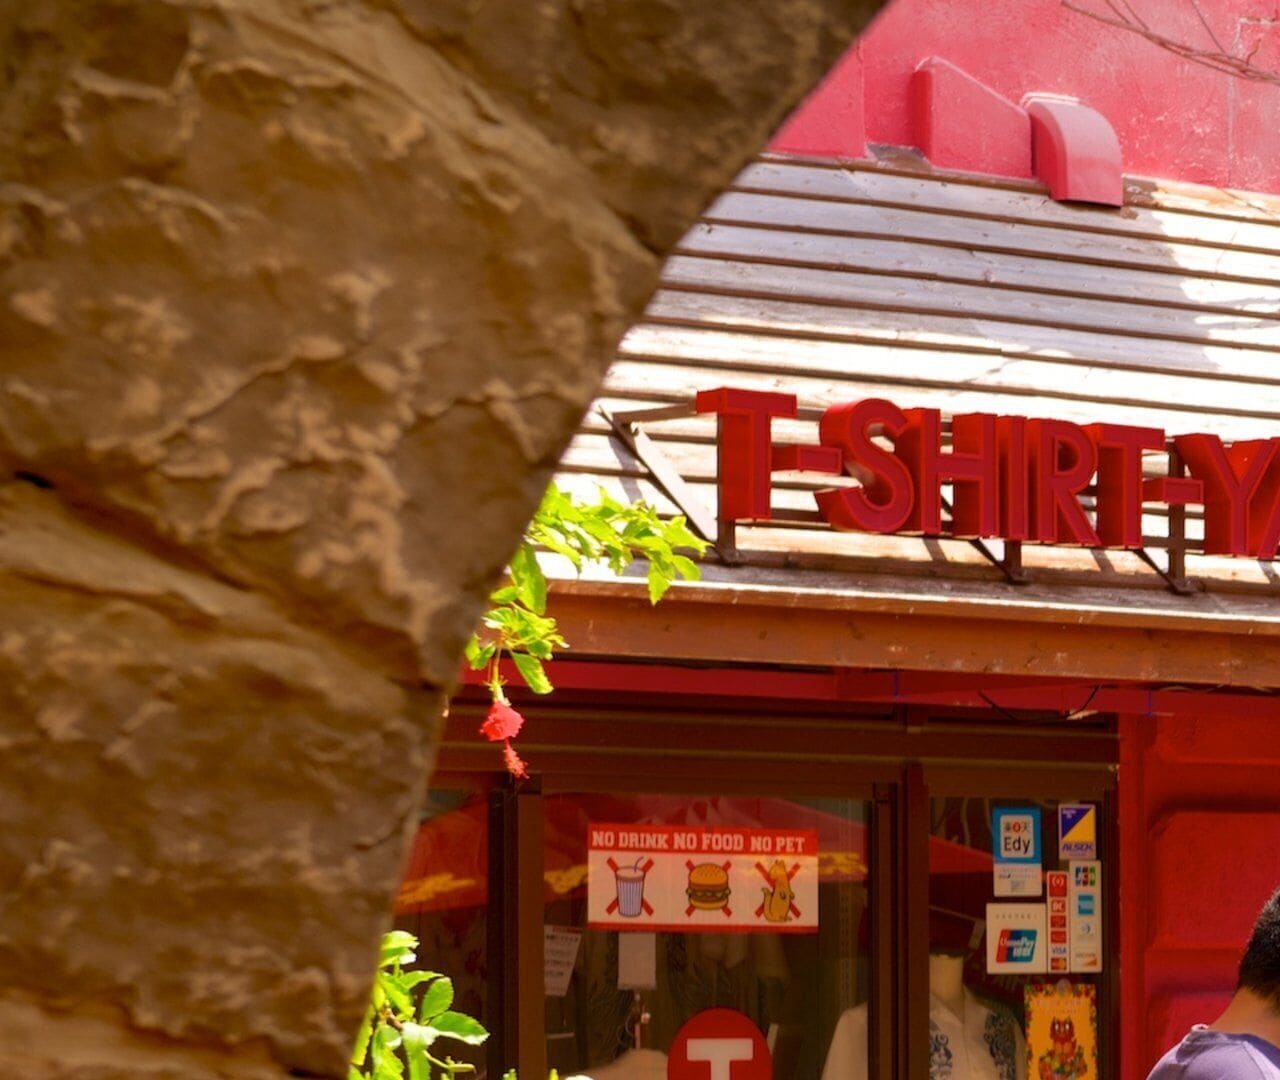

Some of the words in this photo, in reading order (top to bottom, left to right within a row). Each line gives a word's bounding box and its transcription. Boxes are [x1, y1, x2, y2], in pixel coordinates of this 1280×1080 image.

[592, 831, 614, 847] NO
[618, 832, 669, 849] DRINK
[673, 833, 697, 850] NO
[702, 834, 744, 851] FOOD
[751, 837, 772, 851] NO
[776, 837, 805, 852] PET
[1004, 836, 1031, 854] Edy
